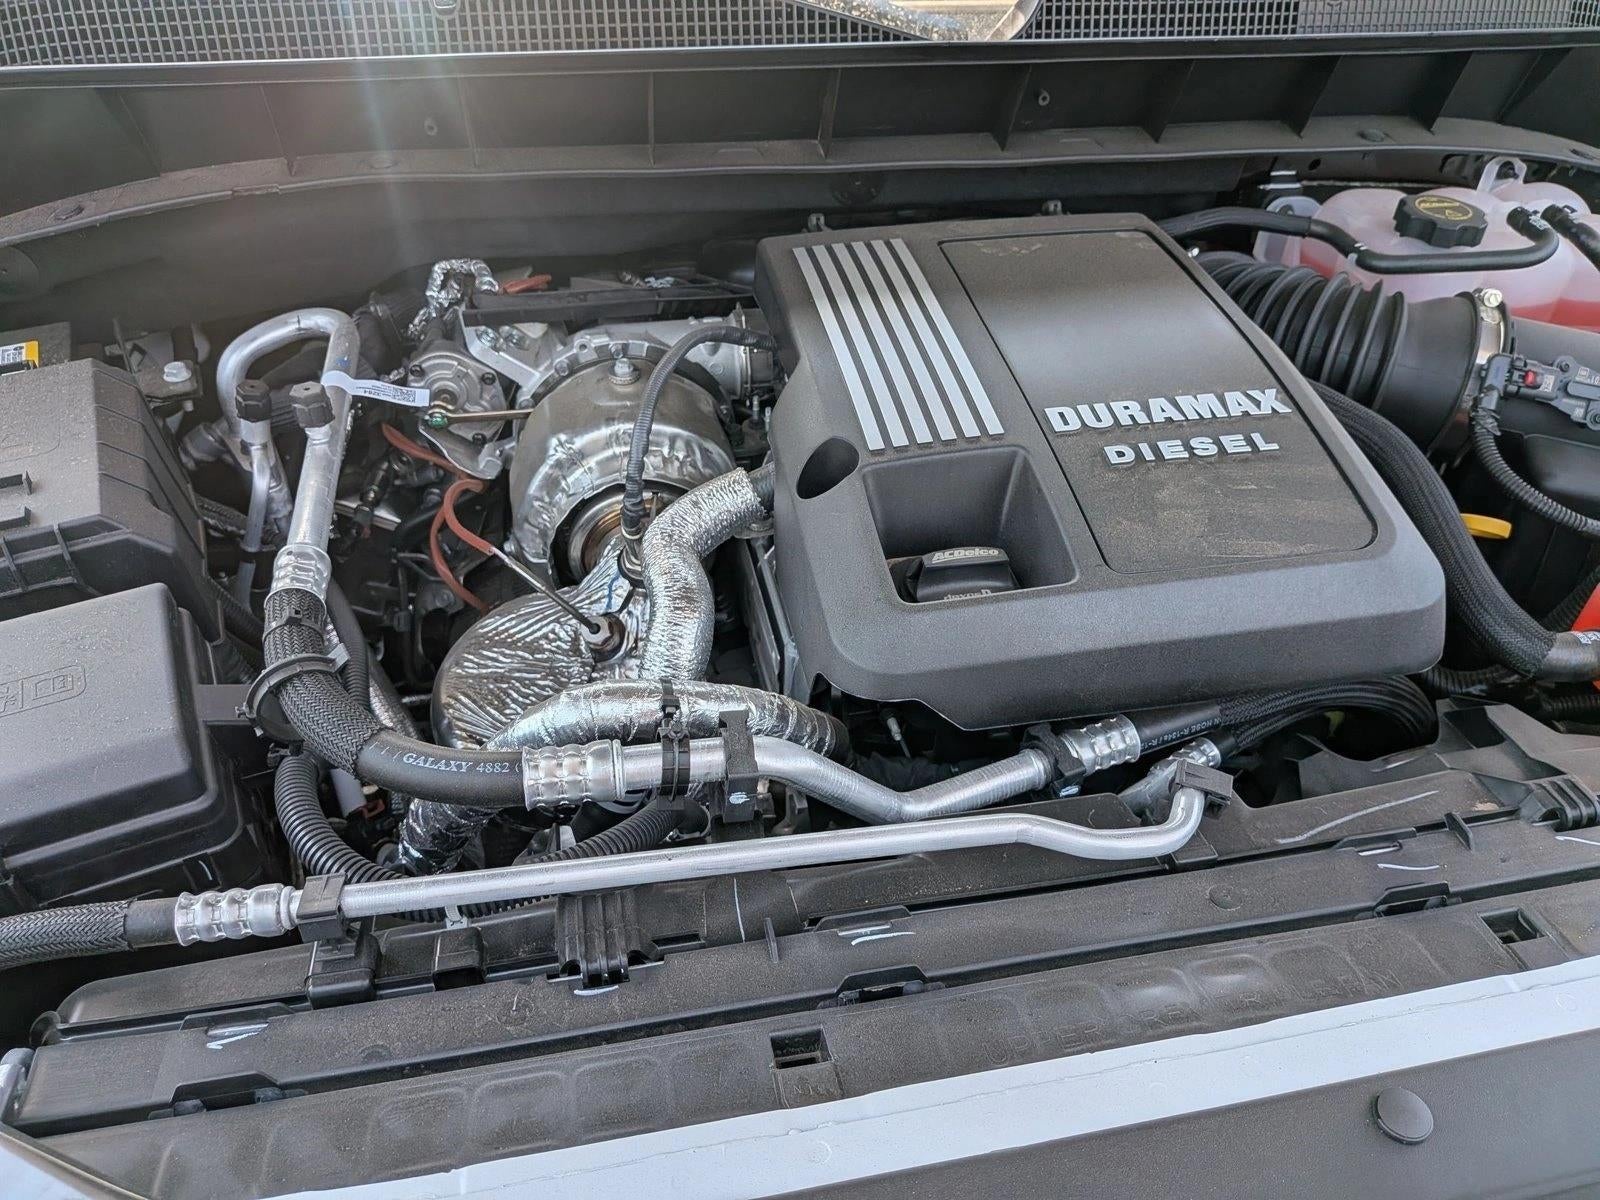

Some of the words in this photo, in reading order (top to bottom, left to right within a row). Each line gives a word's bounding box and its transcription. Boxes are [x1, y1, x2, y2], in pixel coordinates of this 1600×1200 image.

[1044, 389, 1292, 433] DURAMAX
[1104, 433, 1280, 465] DIESEL
[931, 549, 999, 562] ACDelco
[403, 753, 473, 772] GALAXY
[476, 762, 510, 773] 4882
